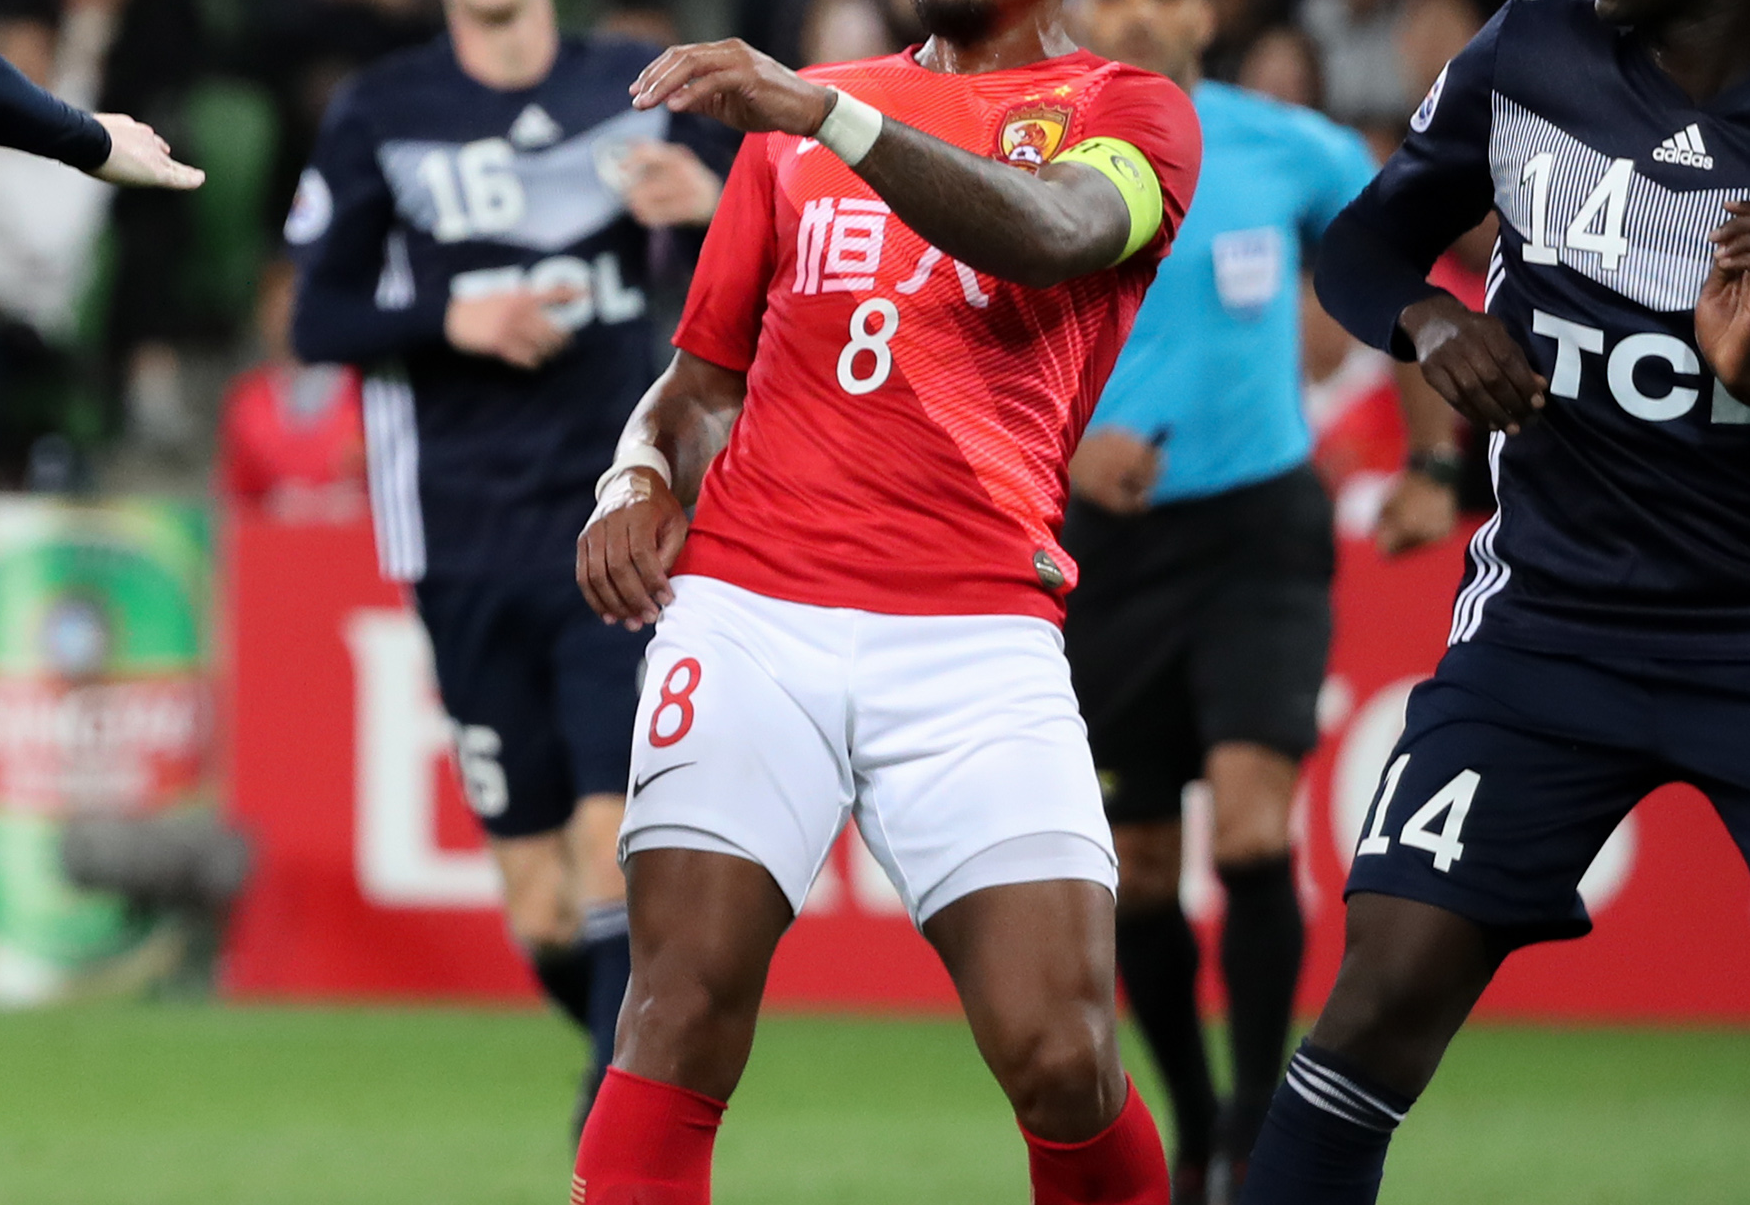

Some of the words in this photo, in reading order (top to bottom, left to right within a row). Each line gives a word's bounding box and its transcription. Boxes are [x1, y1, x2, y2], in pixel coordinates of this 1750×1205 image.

[416, 136, 526, 244] 16
[1521, 151, 1635, 271] 14
[1652, 146, 1714, 171] adidas
[836, 297, 900, 395] 8
[1532, 308, 1750, 425] TC
[649, 657, 702, 749] 8
[1356, 753, 1481, 873] 14
